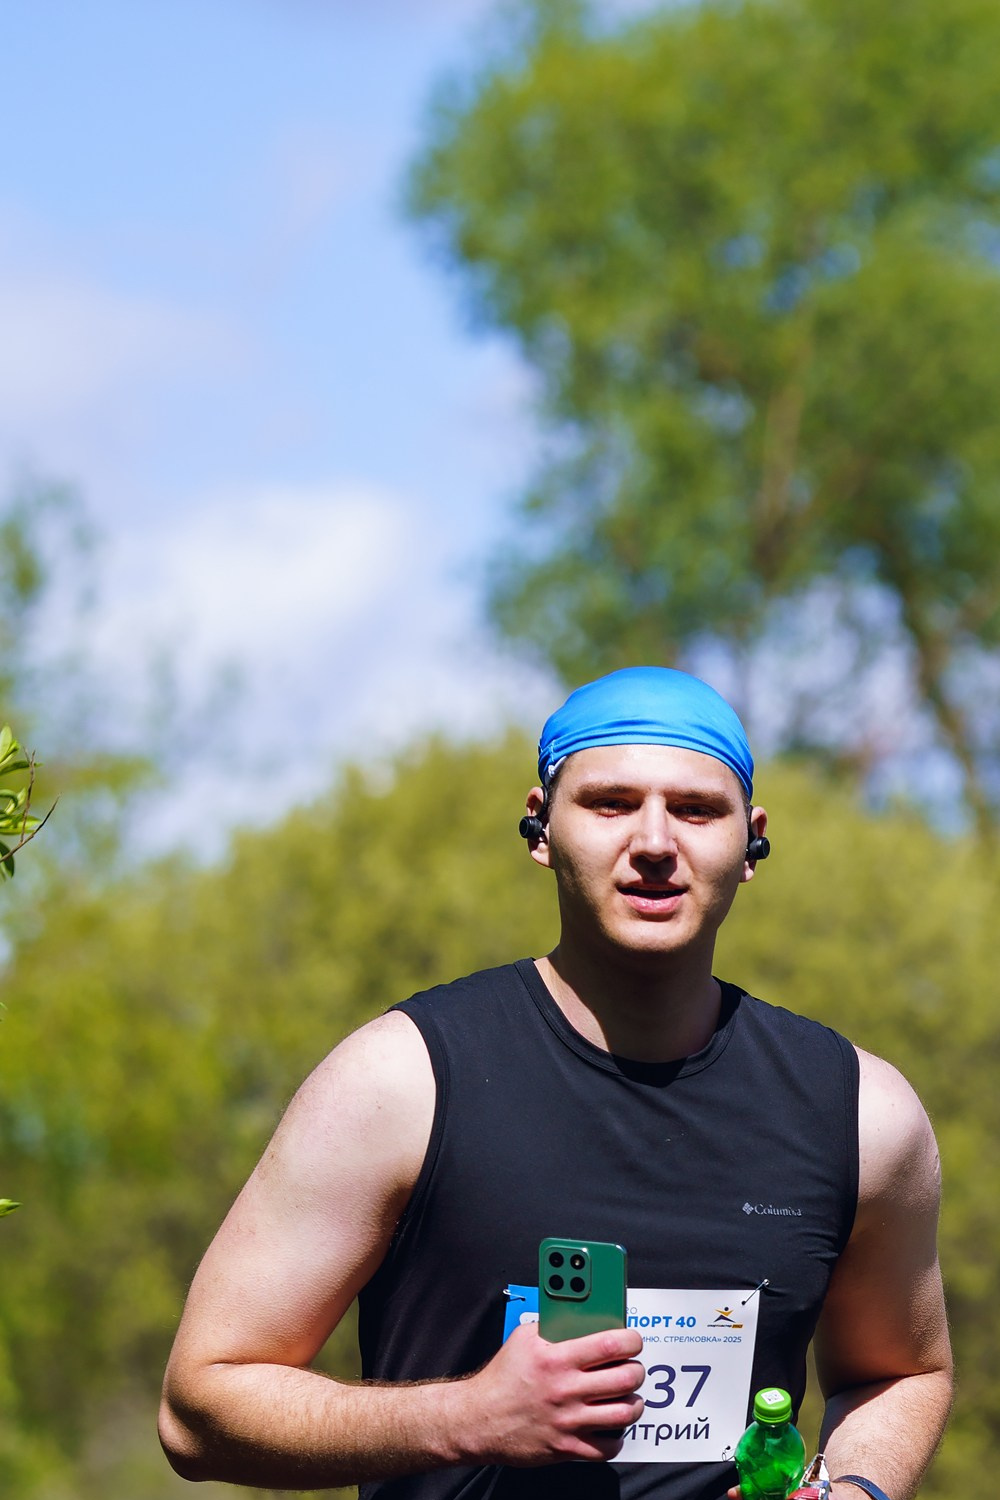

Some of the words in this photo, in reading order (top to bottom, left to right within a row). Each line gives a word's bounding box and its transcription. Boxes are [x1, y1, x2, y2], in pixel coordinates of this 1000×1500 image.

[627, 1315, 673, 1328] ПОРТ
[675, 1315, 697, 1328] 40
[723, 1335, 742, 1344] 2025
[643, 1364, 712, 1409] 37
[622, 1416, 710, 1446] итрий
